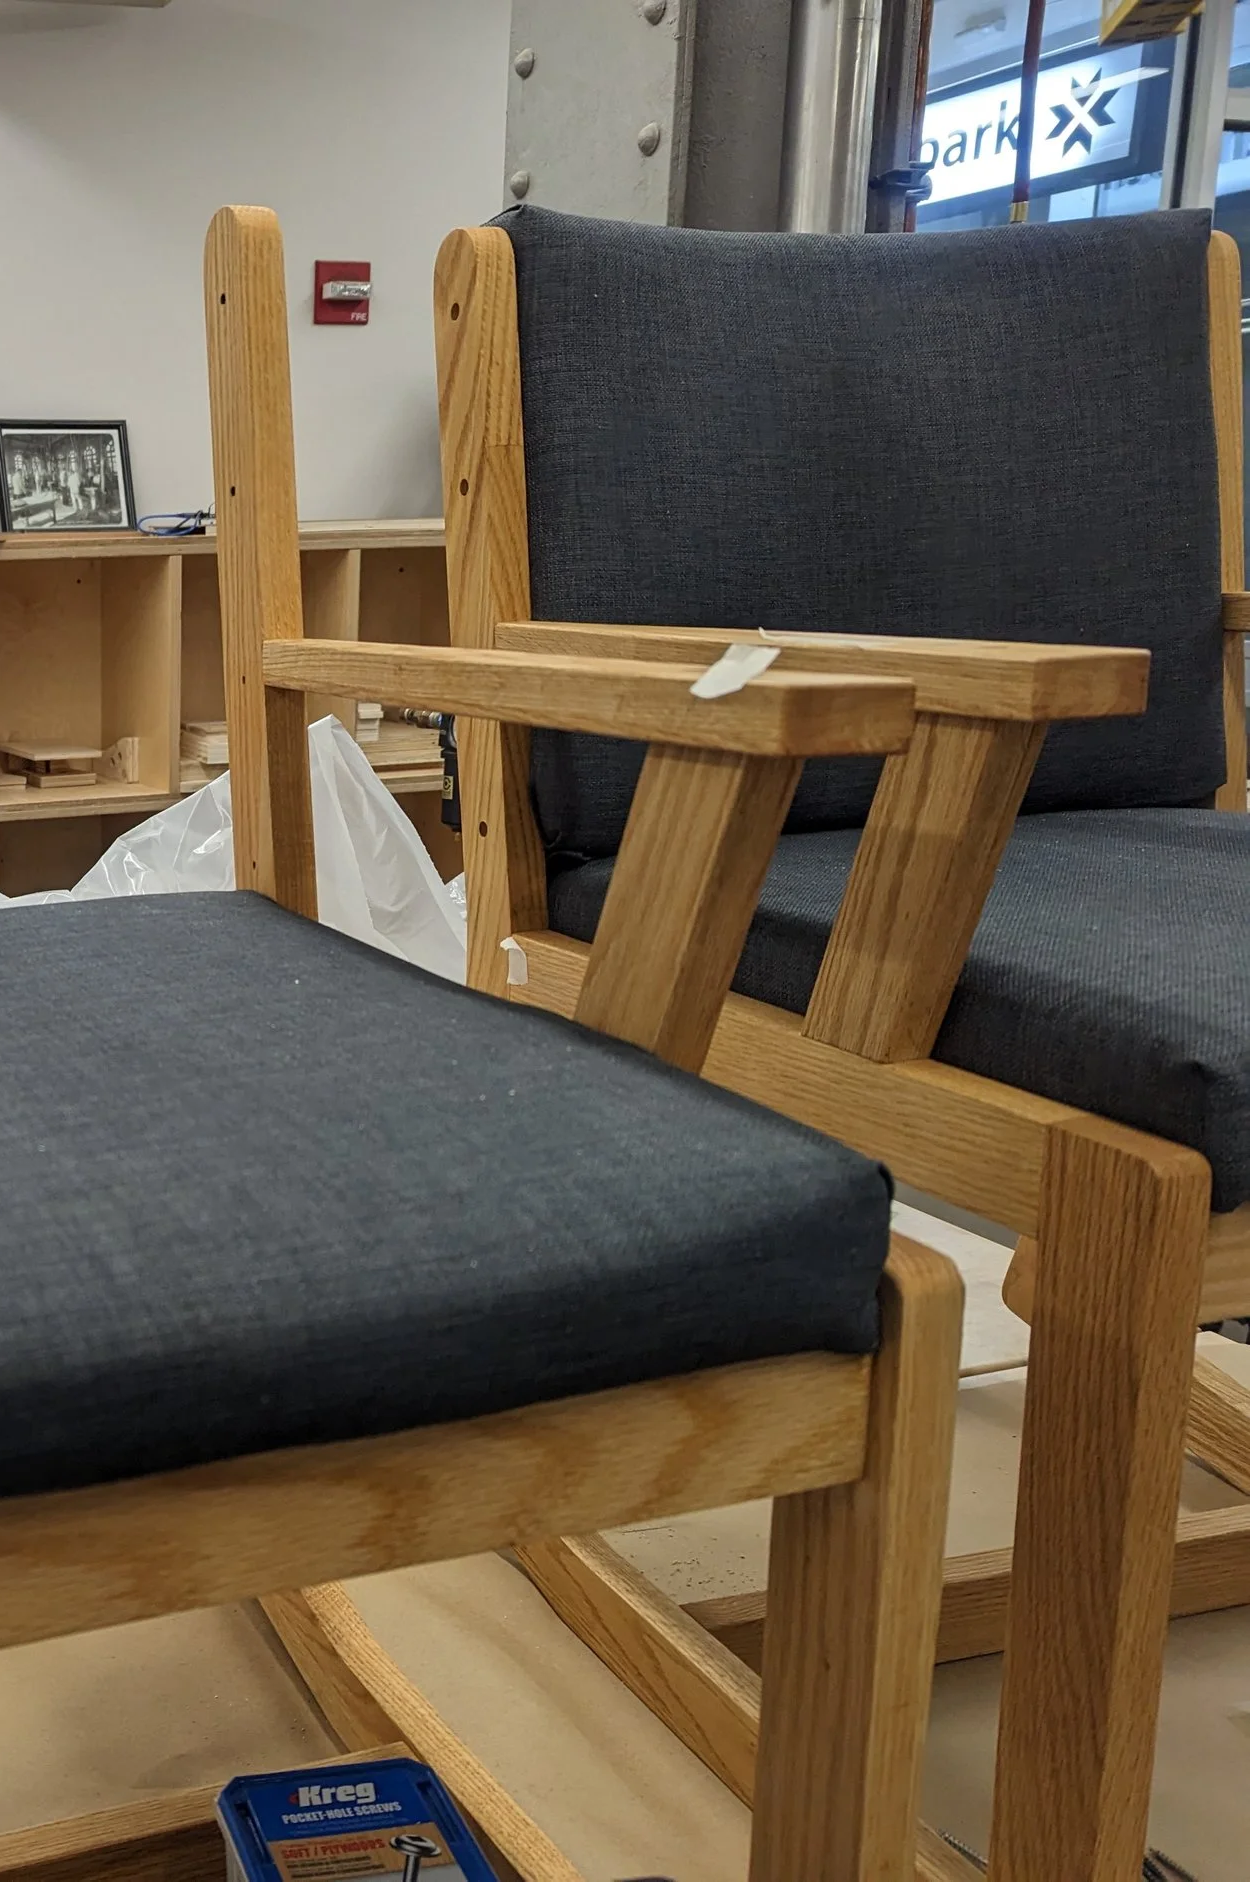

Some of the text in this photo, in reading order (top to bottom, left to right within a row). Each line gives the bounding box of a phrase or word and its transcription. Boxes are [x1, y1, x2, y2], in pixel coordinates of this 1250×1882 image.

[351, 312, 368, 321] FIRE
[298, 1782, 376, 1807] Kreg
[281, 1801, 402, 1824] POCKET-HOLE SCREWS
